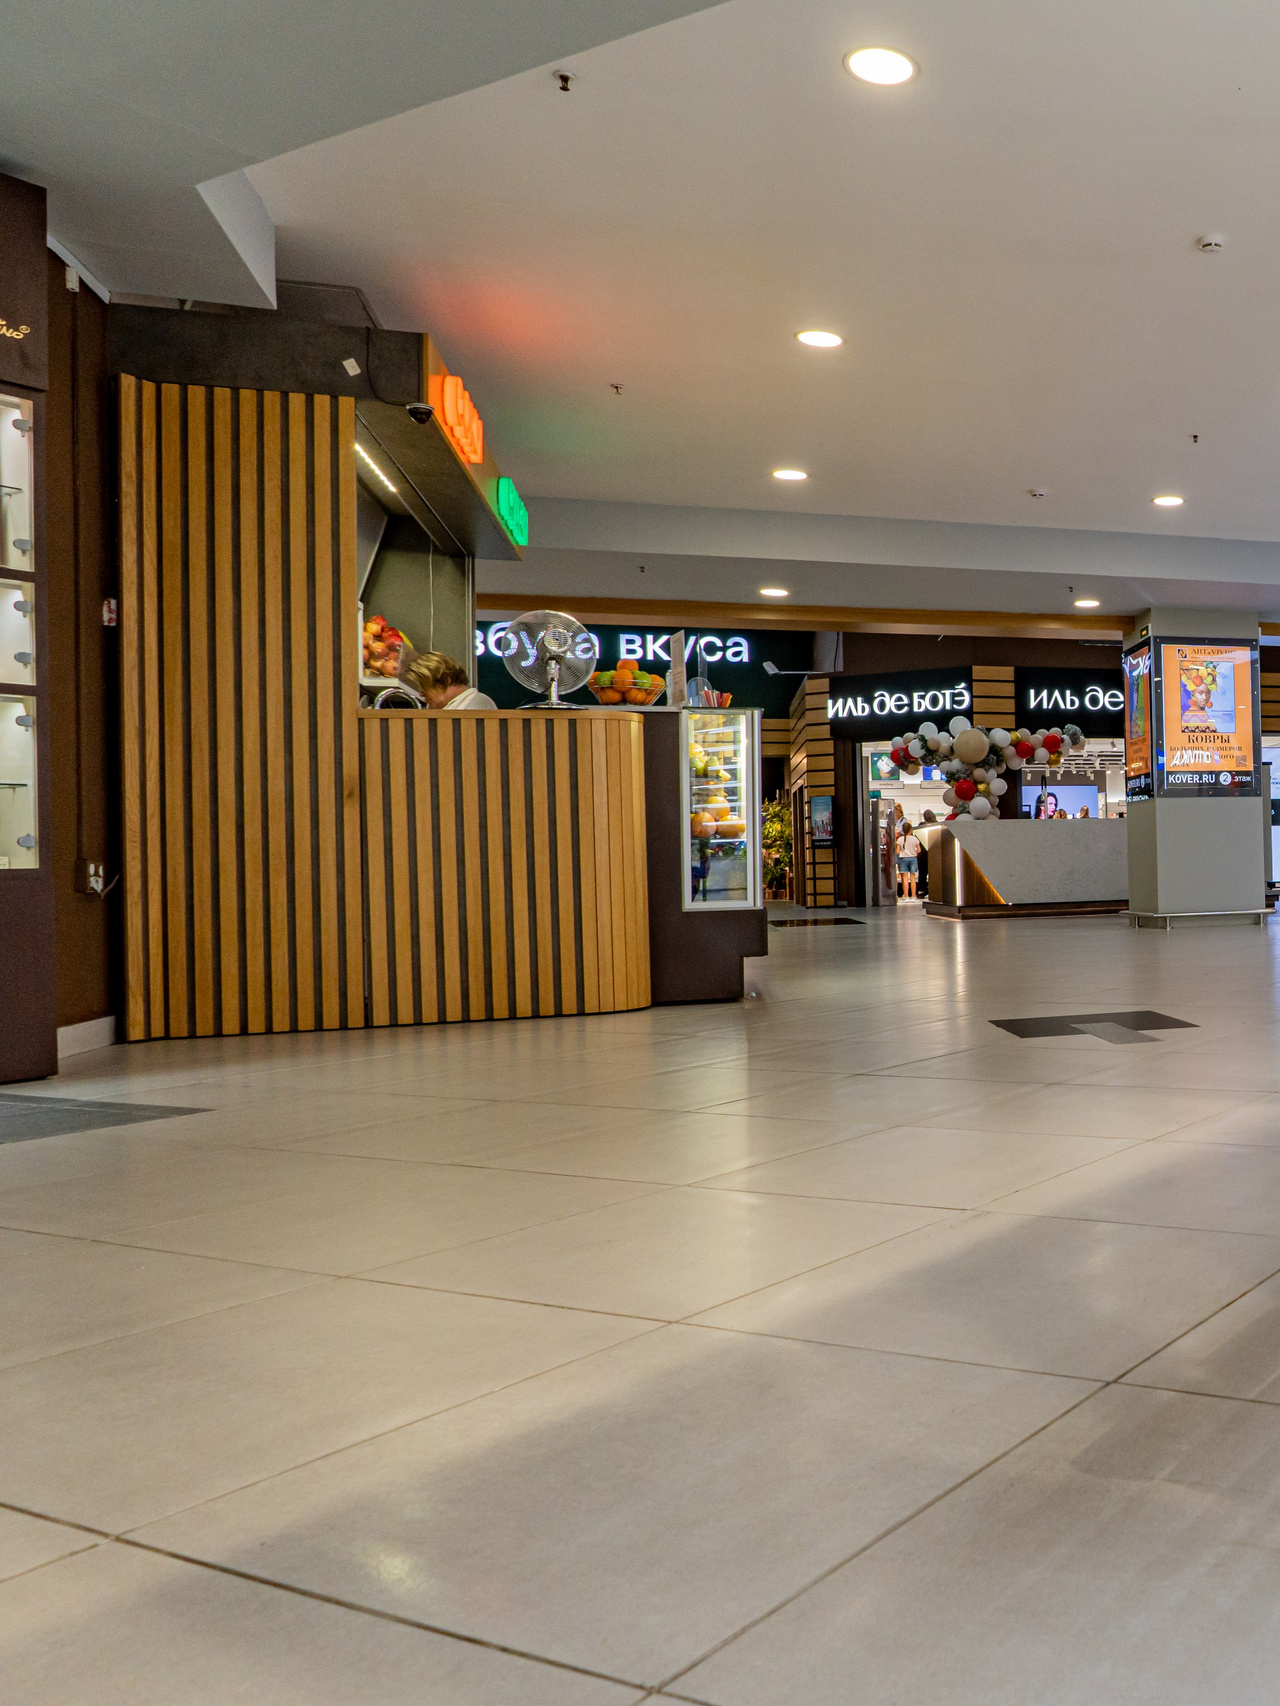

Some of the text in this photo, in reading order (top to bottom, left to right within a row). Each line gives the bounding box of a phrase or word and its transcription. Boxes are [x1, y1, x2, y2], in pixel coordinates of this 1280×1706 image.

[1029, 688, 1080, 710] ИЛЬ
[827, 697, 870, 719] ИЛЬ
[1187, 734, 1231, 744] КОВРЫ
[1168, 774, 1216, 784] KOVER.RU
